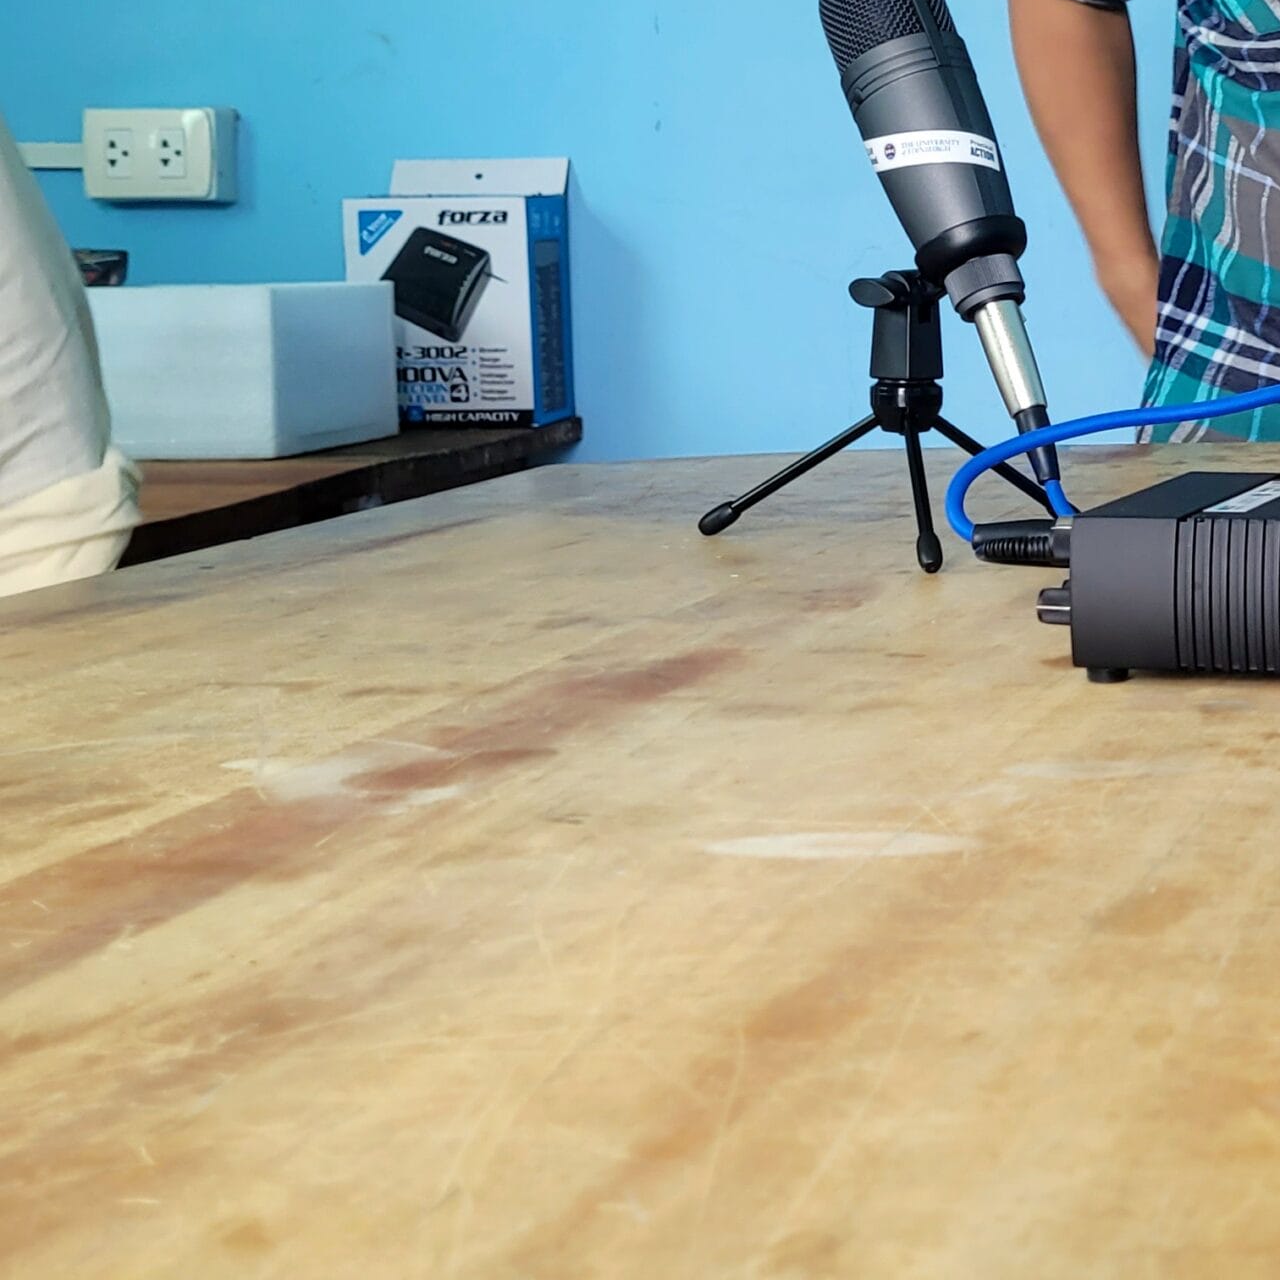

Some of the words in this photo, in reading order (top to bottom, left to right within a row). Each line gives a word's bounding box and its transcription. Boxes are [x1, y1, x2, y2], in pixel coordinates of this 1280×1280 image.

[438, 209, 509, 226] forza
[426, 413, 456, 423] HIGH
[458, 411, 520, 422] CAPACITY
